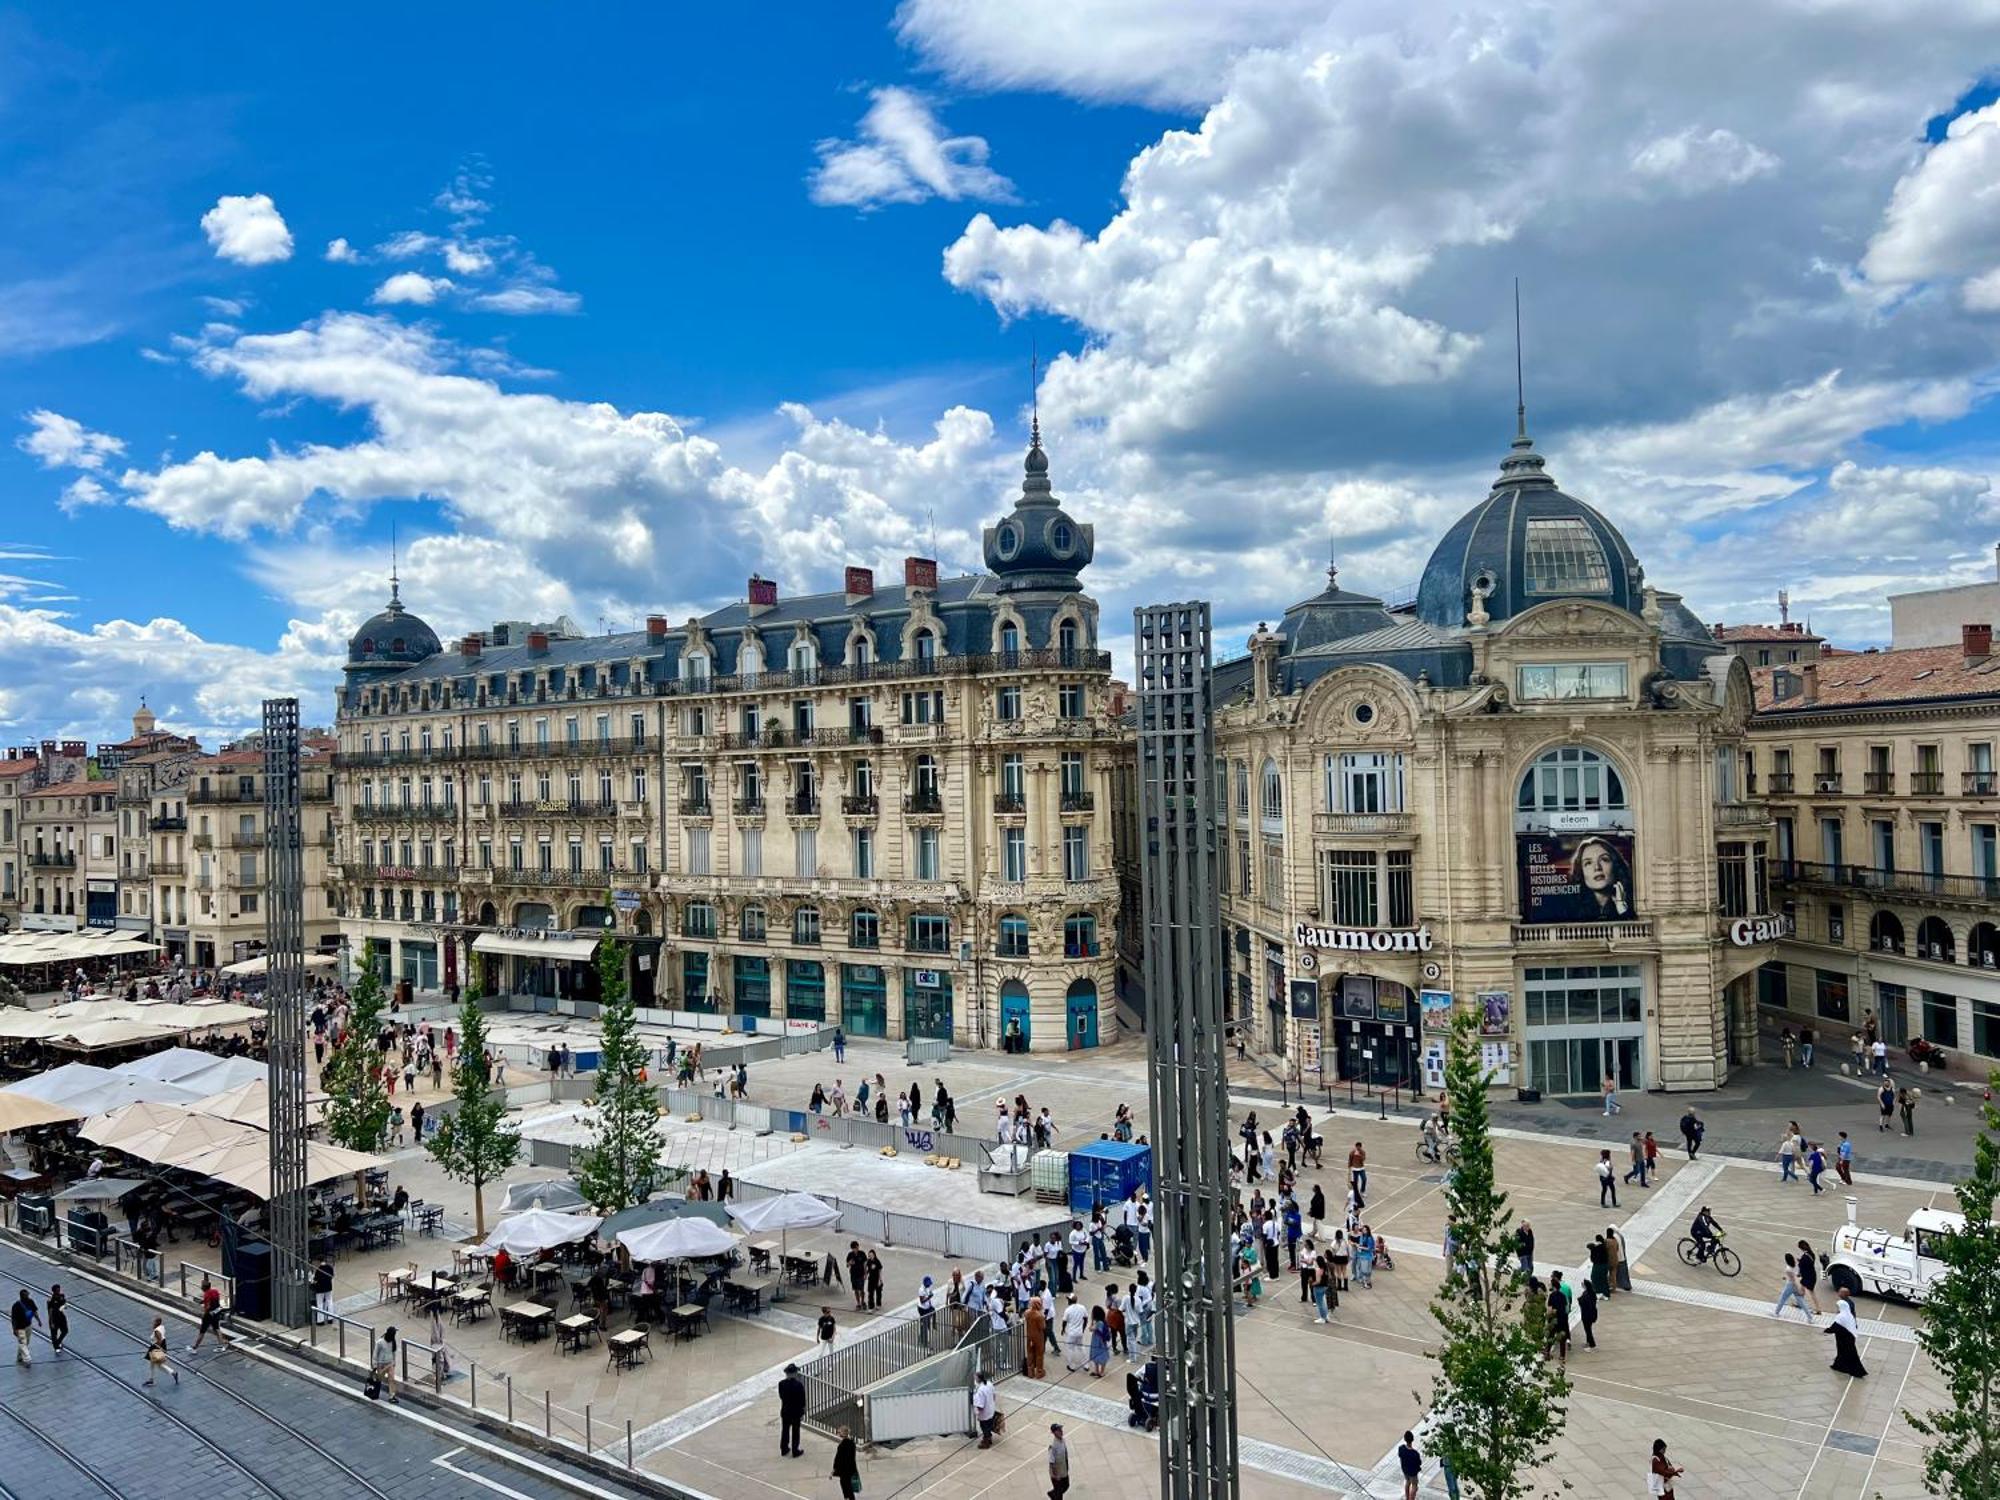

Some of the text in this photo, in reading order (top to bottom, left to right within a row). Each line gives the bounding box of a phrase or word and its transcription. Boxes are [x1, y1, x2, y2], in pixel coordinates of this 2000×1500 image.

[1528, 843, 1542, 853] LES
[1529, 854, 1548, 863] PLUS
[1530, 865, 1556, 874] BELLES
[1530, 874, 1568, 885] HISTOIRES
[1531, 884, 1581, 896] COMMENCENT
[1531, 896, 1543, 907] ICI
[1295, 923, 1433, 951] Gaumont
[1731, 919, 1784, 946] Gau
